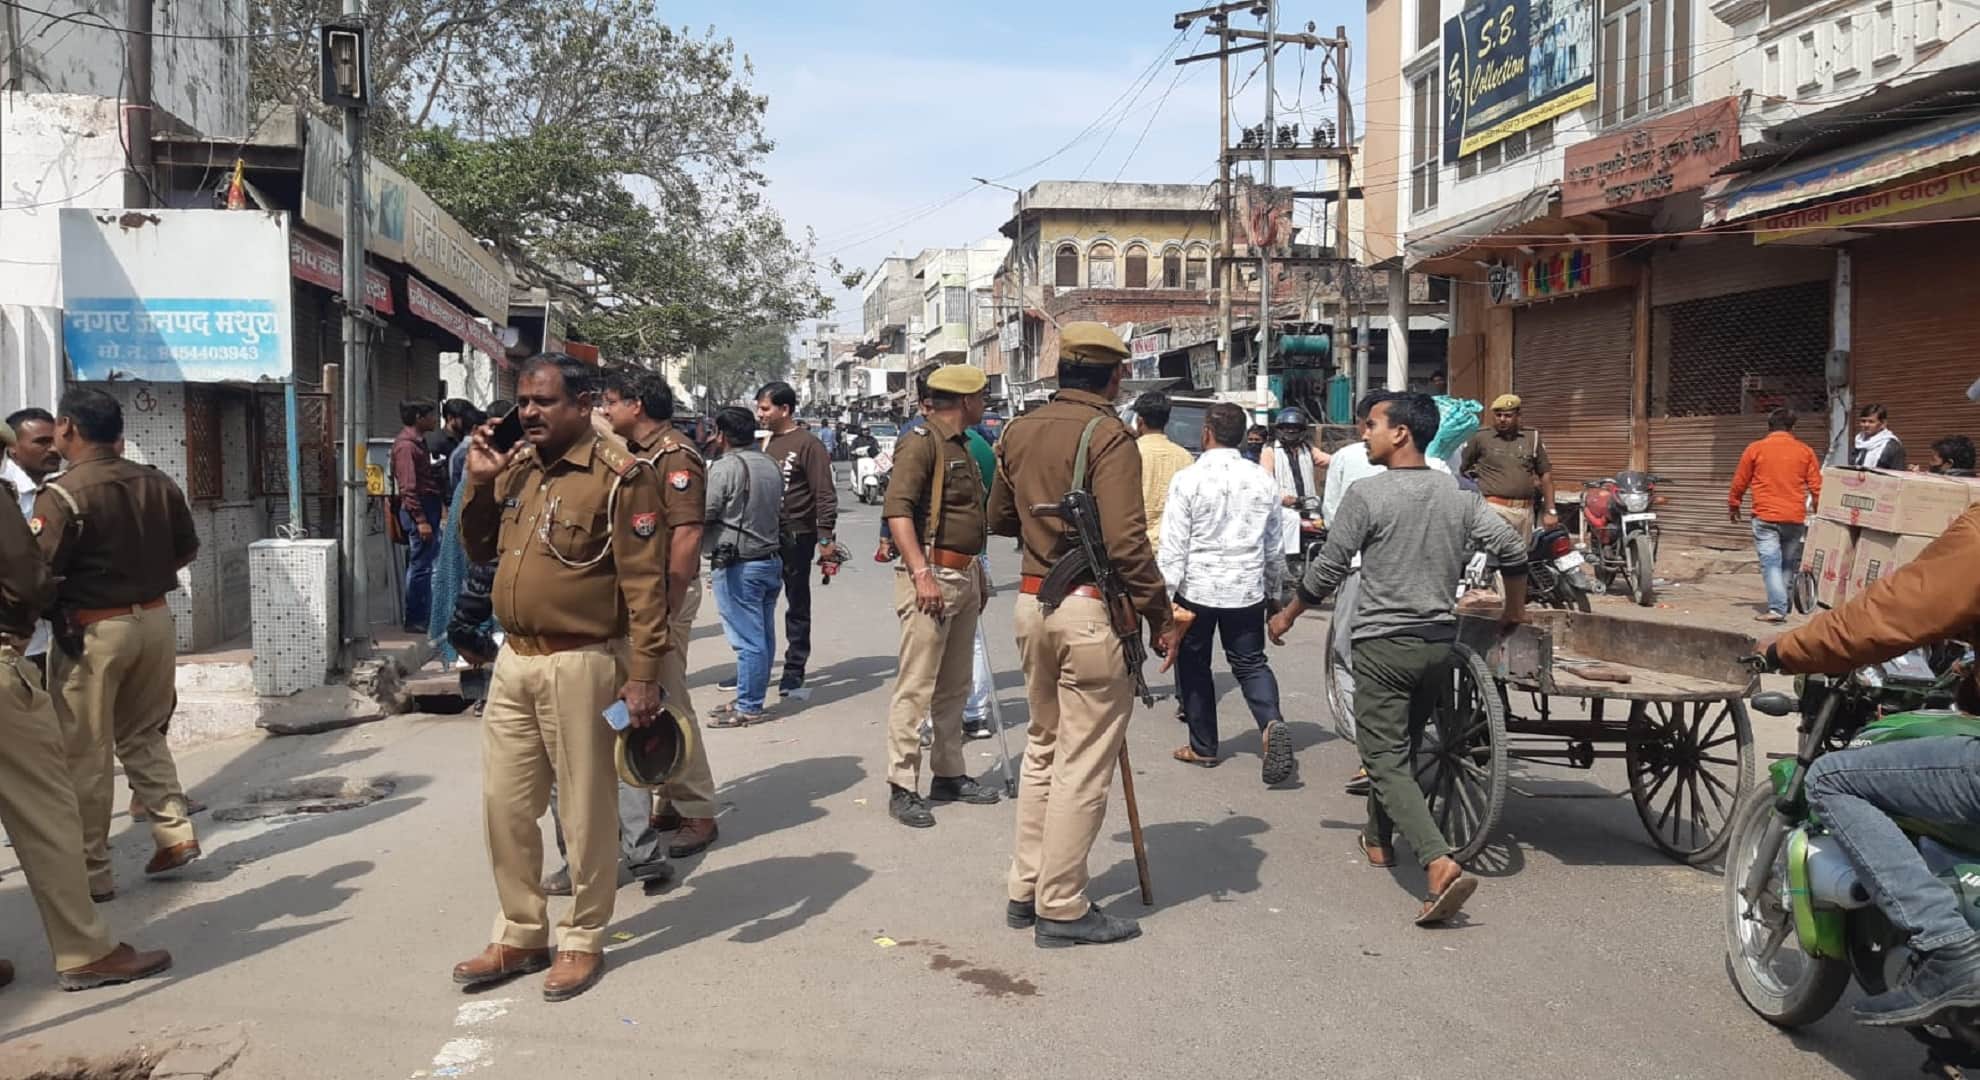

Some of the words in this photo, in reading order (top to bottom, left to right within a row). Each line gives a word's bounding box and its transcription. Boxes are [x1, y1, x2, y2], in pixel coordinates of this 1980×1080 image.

[1470, 55, 1525, 107] Collection
[72, 310, 130, 334] नगर
[136, 310, 211, 336] जनपद
[214, 309, 280, 345] मथुरा
